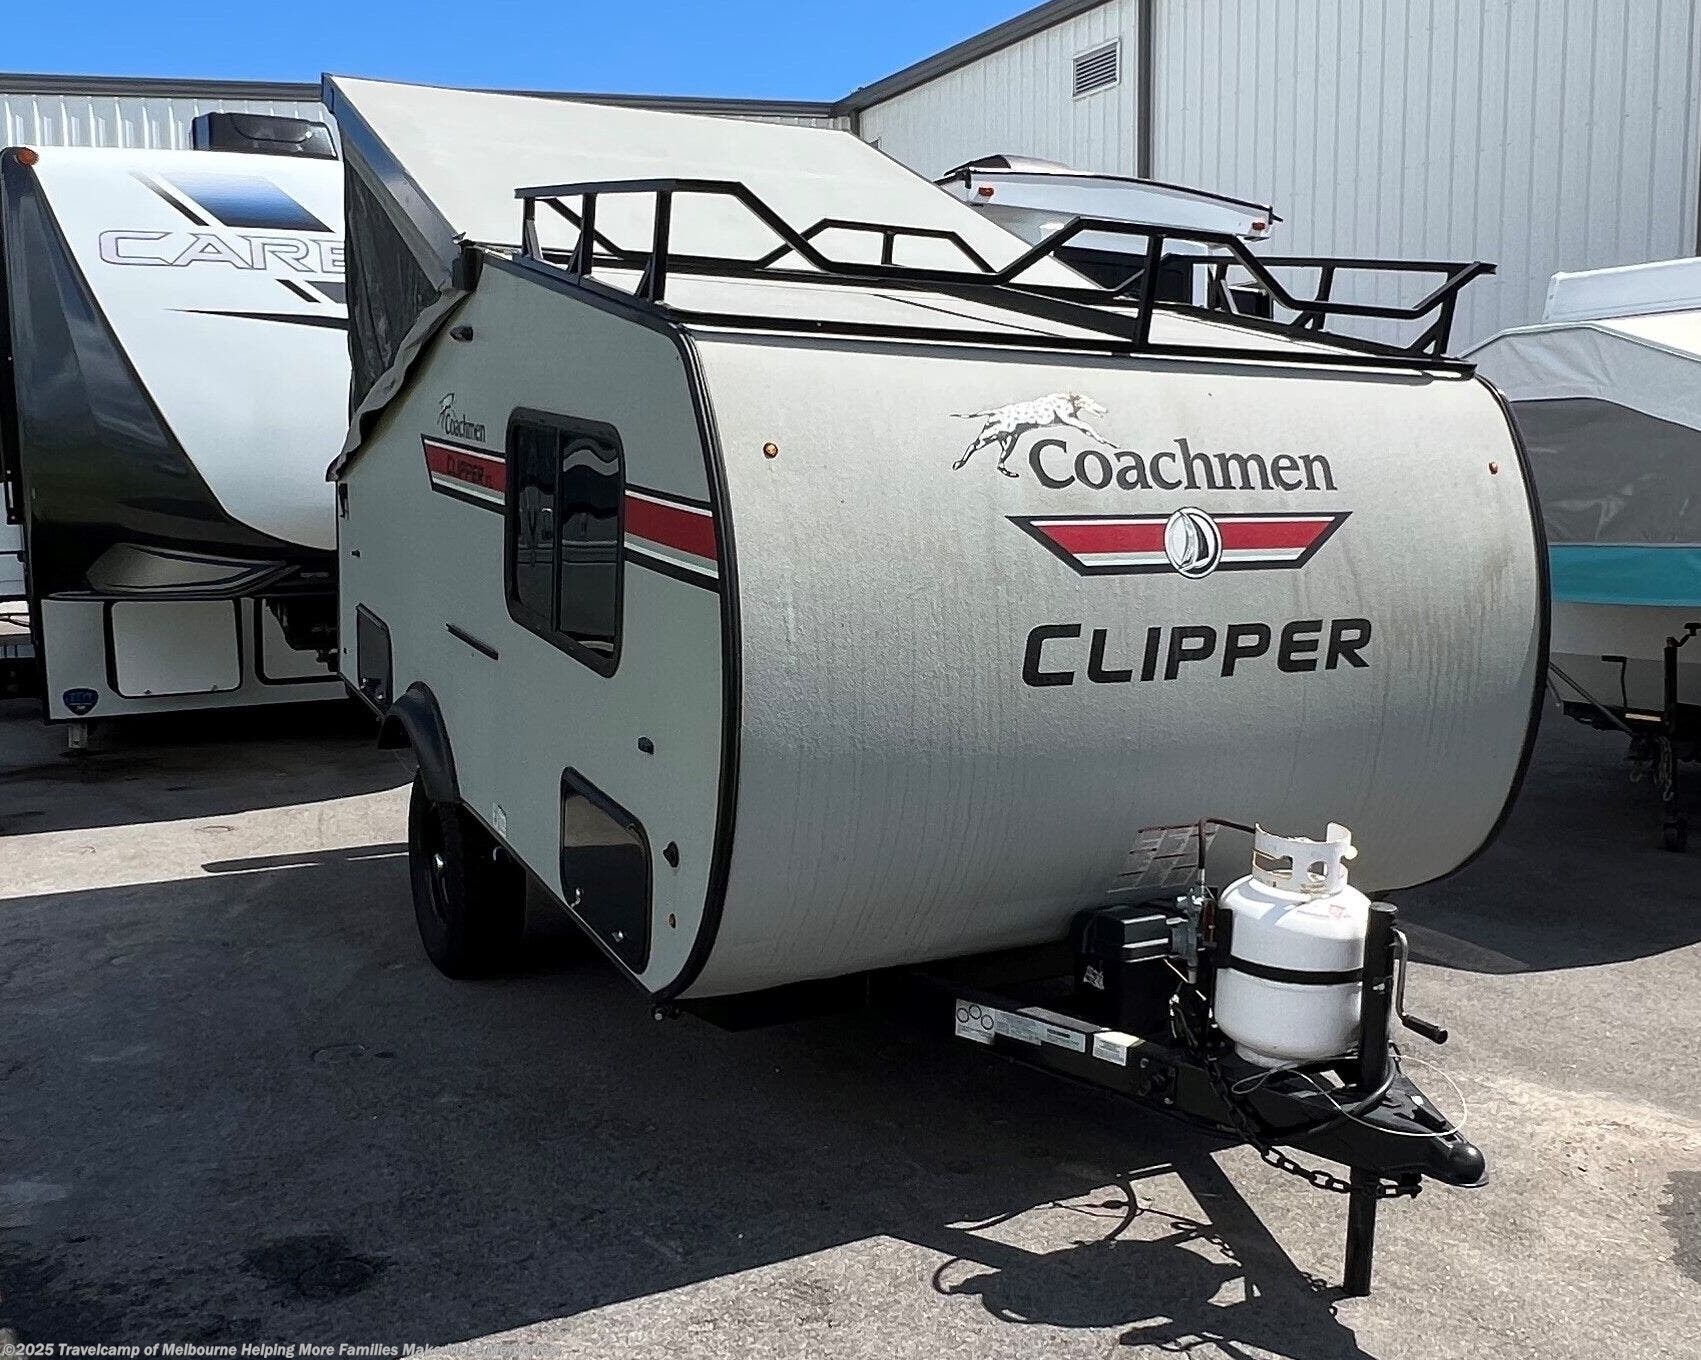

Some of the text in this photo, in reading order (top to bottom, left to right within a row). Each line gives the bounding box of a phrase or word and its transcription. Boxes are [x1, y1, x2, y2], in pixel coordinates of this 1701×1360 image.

[444, 412, 486, 442] Coachmen
[1027, 437, 1338, 492] Coachmen
[1022, 618, 1373, 687] CLIPPER
